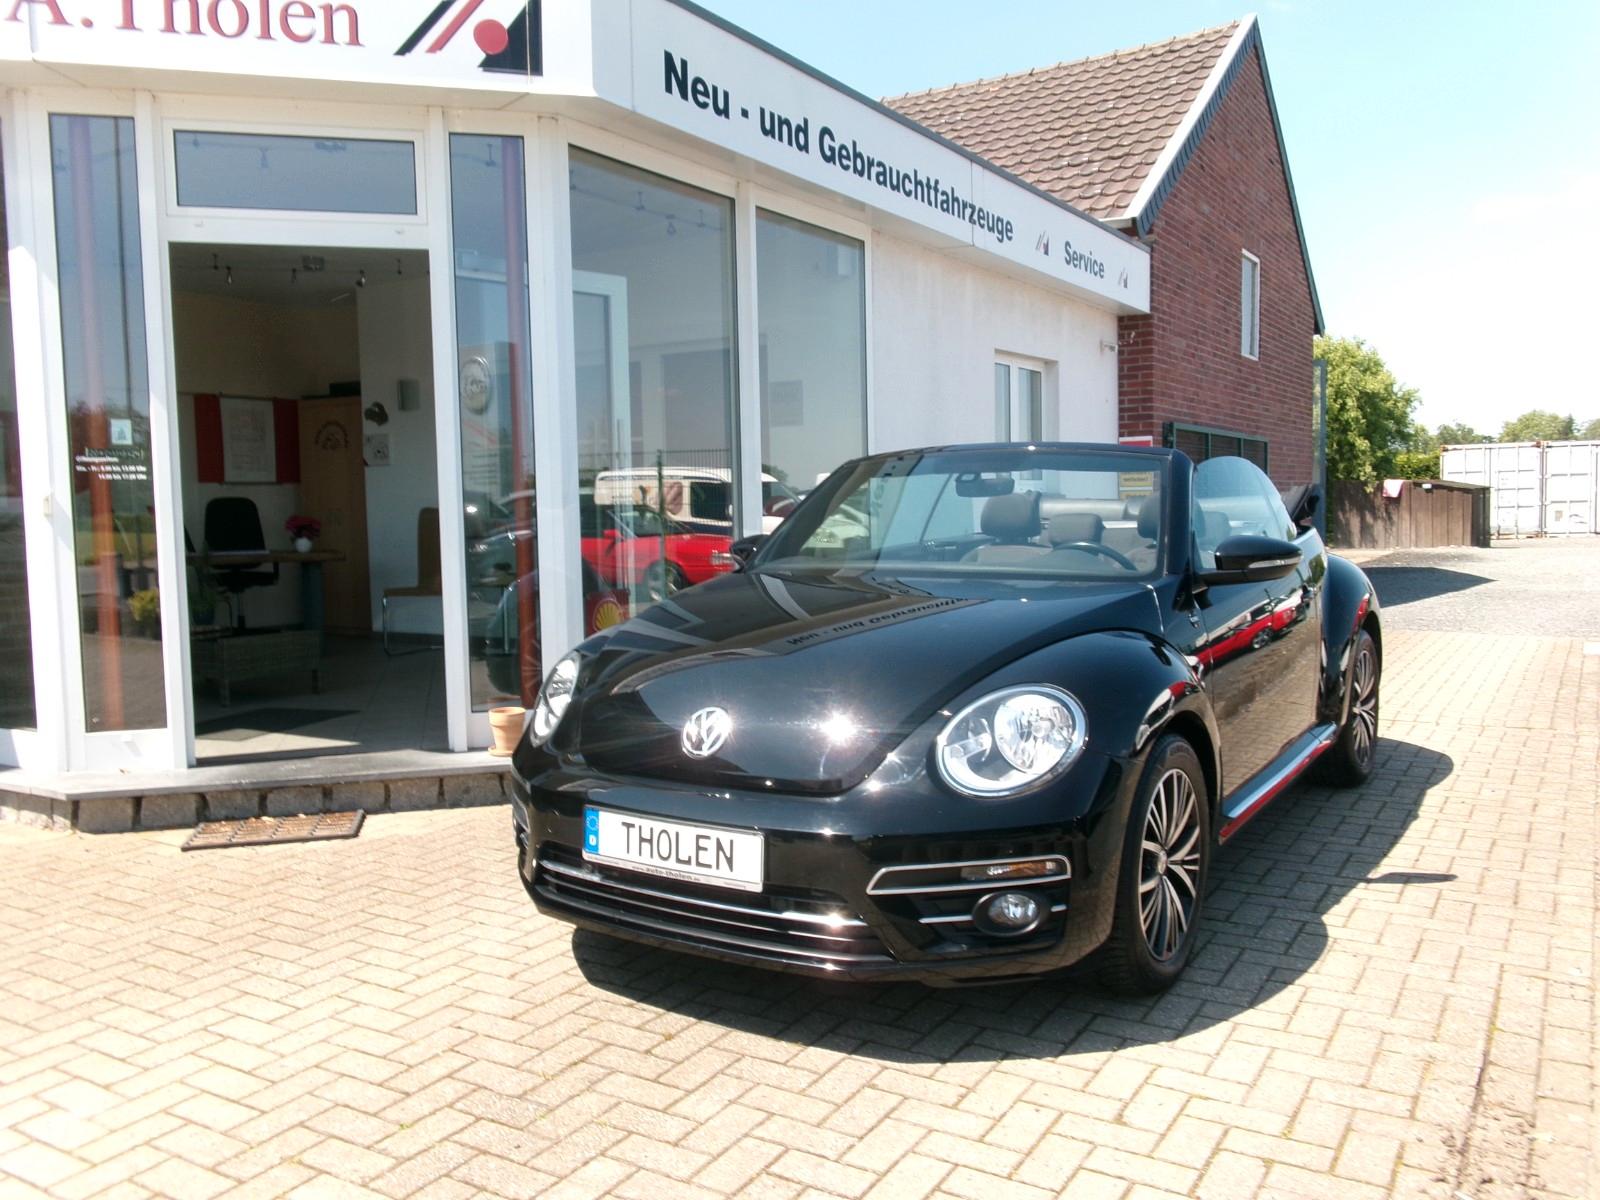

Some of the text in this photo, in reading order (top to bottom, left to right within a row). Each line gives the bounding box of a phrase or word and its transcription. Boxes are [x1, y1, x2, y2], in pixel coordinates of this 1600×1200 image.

[663, 49, 1014, 243] Neu - und Gebrauchtfahrzeuge
[1064, 240, 1105, 279] Service
[621, 821, 734, 873] THOLEN
